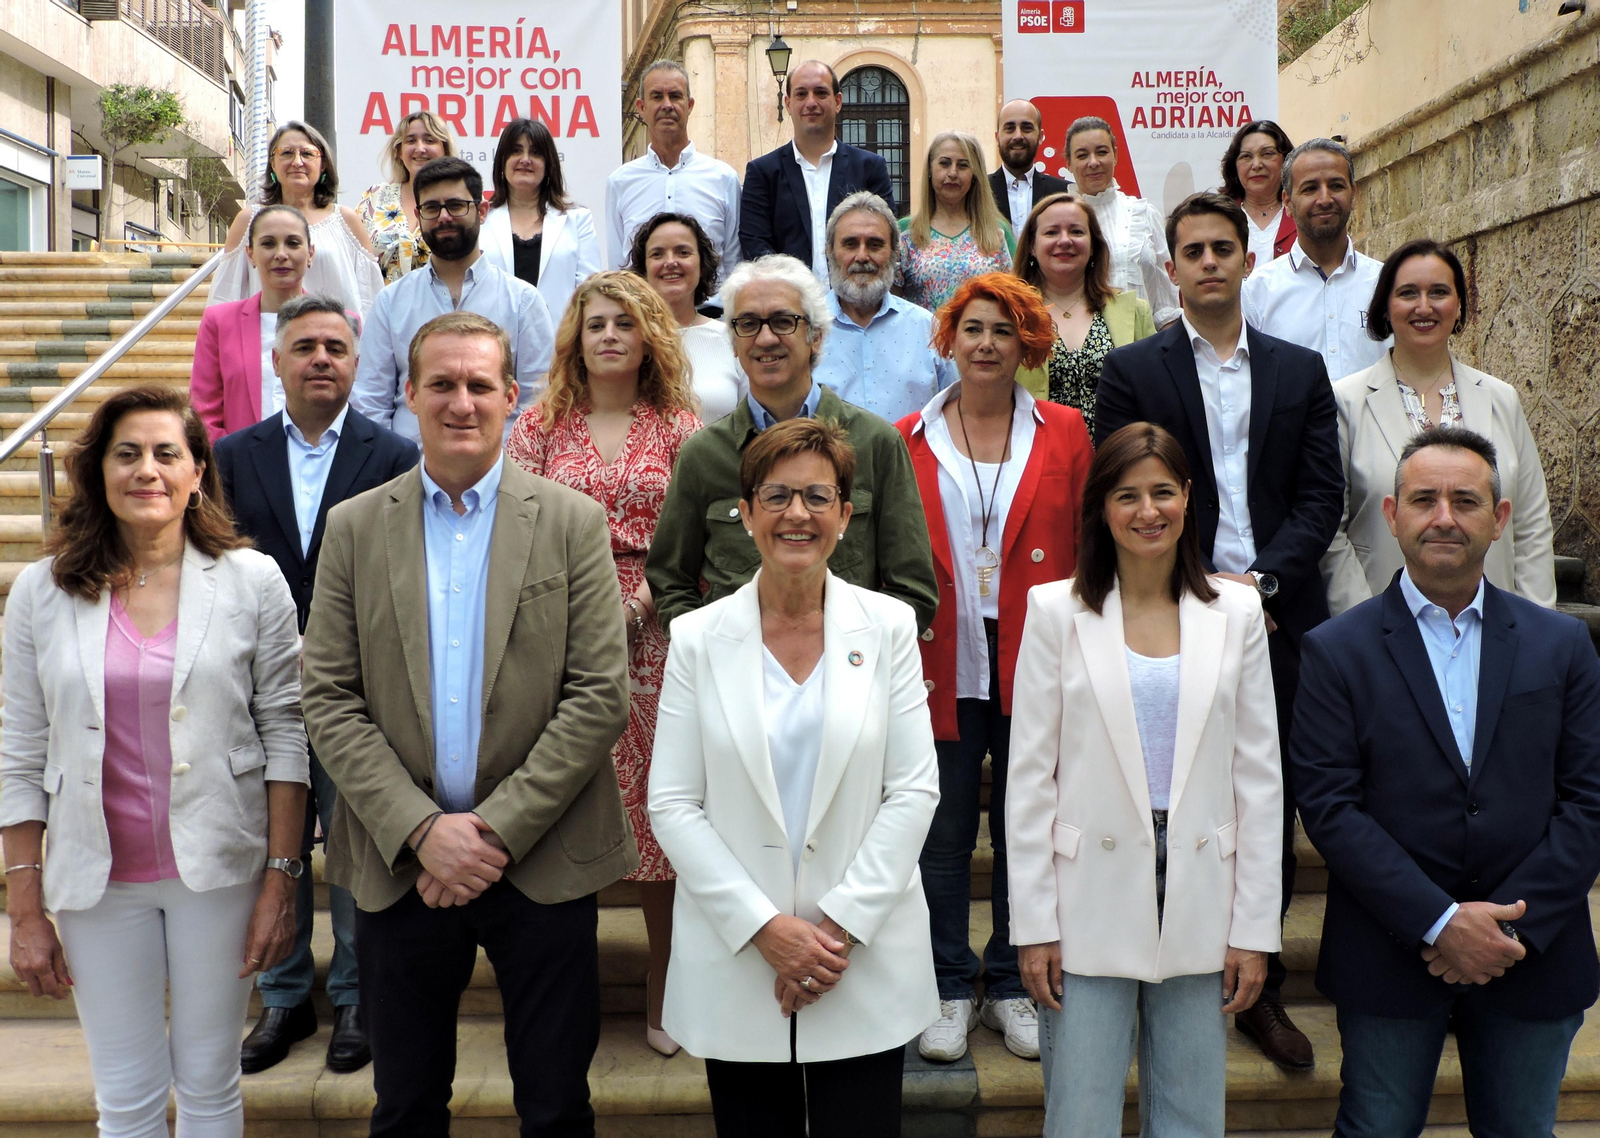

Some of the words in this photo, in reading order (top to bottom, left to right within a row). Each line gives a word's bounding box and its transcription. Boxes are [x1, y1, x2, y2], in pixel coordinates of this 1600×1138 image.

[1020, 15, 1048, 27] PSOE
[381, 17, 561, 64] ALMERÍA,
[411, 58, 511, 96] mejor
[520, 66, 582, 90] con
[1131, 66, 1223, 89] ALMERÍA,
[1156, 87, 1208, 107] mejor
[1212, 90, 1245, 103] con
[1130, 105, 1254, 129] ADRIANA
[1151, 130, 1189, 139] Candidata
[1197, 130, 1205, 139] la
[1206, 130, 1236, 138] Alcaldía
[479, 151, 487, 161] a
